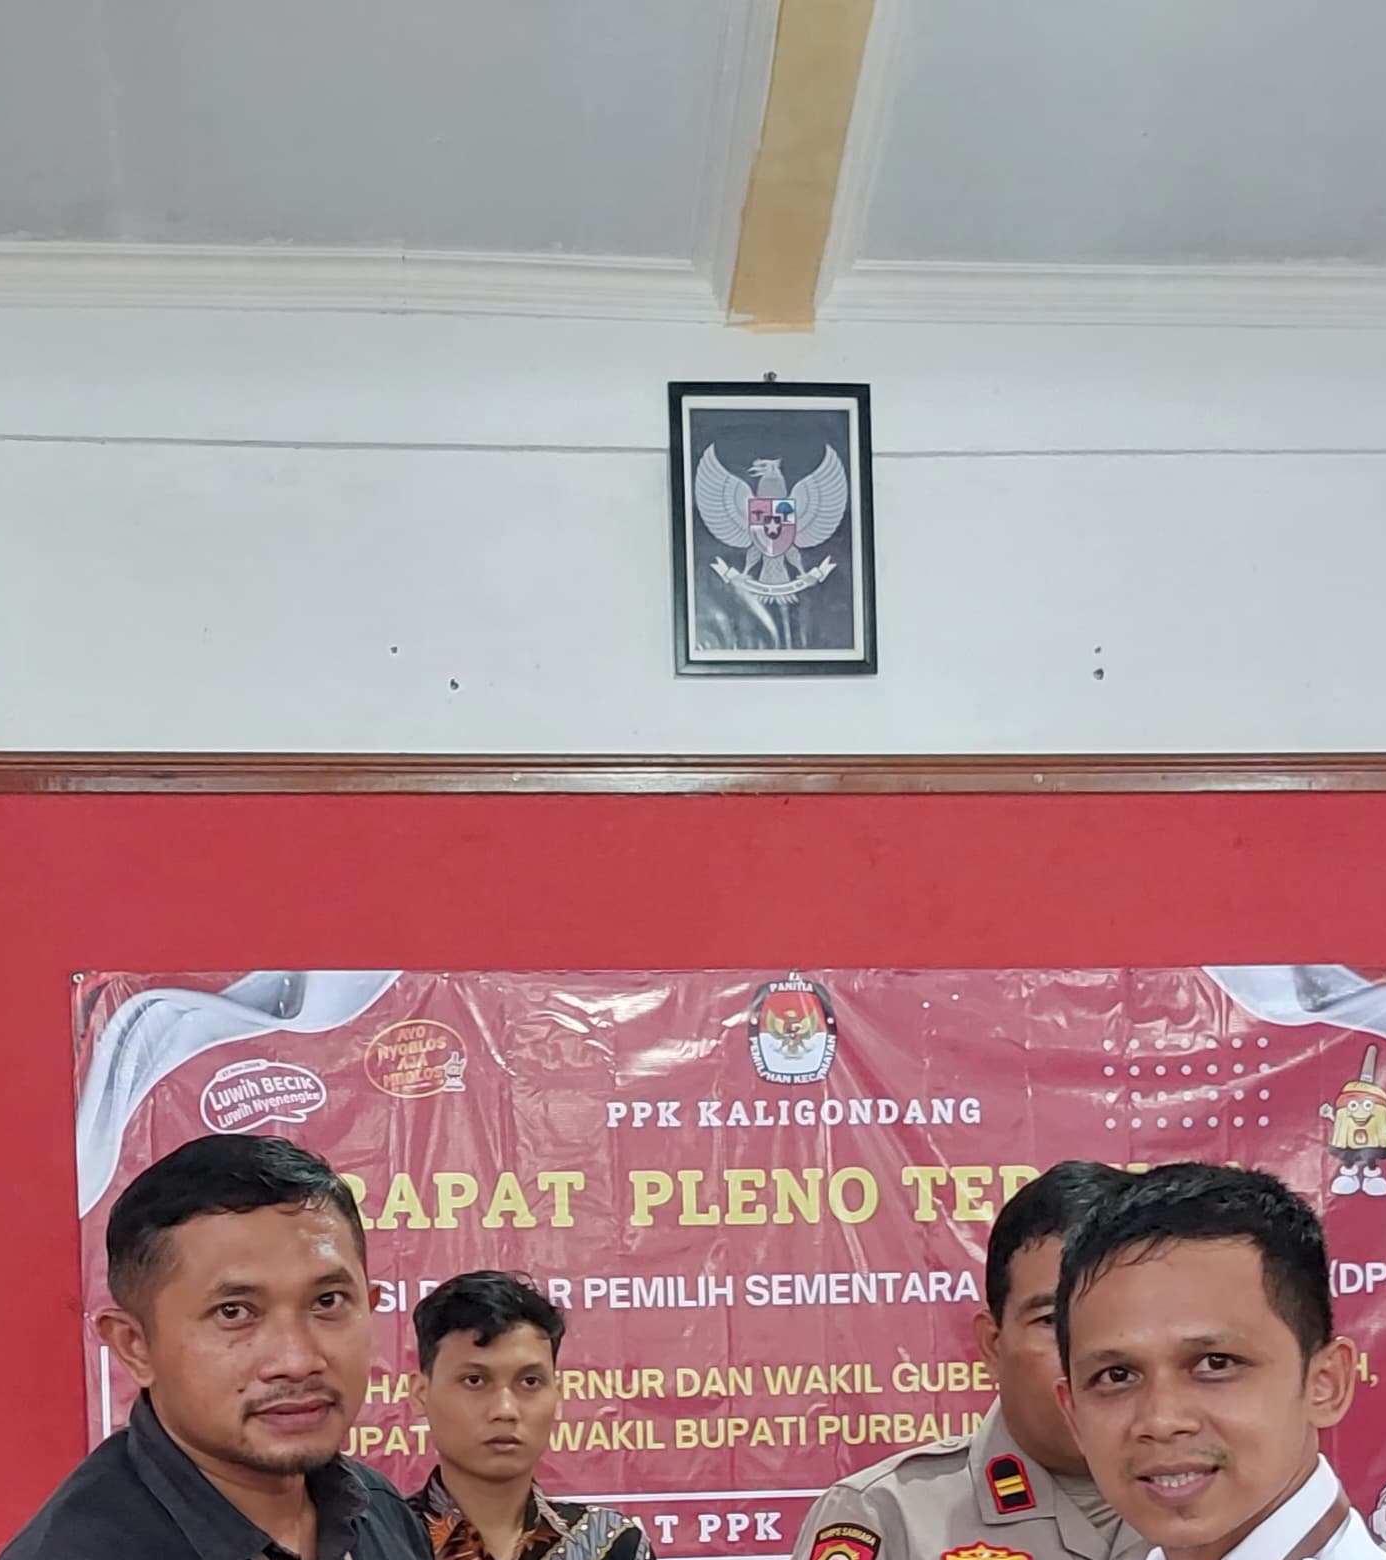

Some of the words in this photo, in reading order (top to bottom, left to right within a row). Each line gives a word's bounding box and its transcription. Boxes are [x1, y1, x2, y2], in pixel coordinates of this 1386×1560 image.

[261, 1076, 315, 1093] BECIK
[606, 1101, 682, 1127] PPK
[698, 1098, 982, 1126] KALIGONDANG
[628, 1166, 879, 1226] PLENO
[584, 1275, 734, 1310] PEMILIH
[745, 1271, 980, 1307] SEMENTARA
[676, 1366, 753, 1398] DAN
[763, 1363, 883, 1396] WAKIL
[892, 1361, 999, 1393] GUBE
[550, 1420, 666, 1452] WAKIL
[675, 1416, 807, 1449] BUPATI
[698, 1512, 782, 1543] PPK
